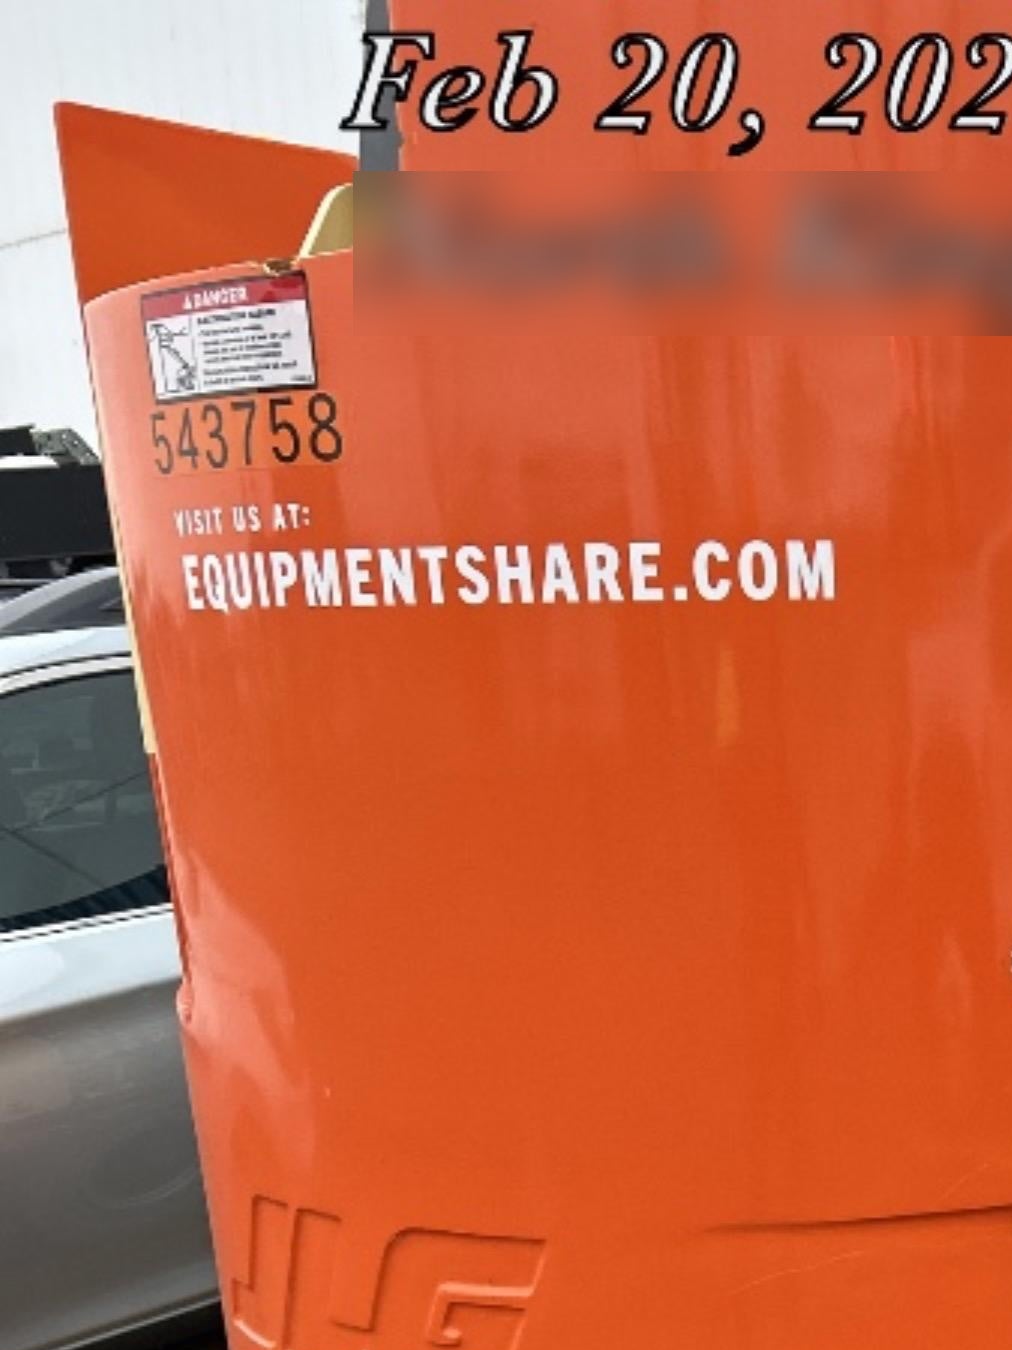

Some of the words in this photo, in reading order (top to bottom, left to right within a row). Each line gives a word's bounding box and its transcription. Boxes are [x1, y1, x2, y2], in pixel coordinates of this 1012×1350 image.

[149, 391, 343, 475] 543758
[174, 506, 223, 537] VISIT
[232, 505, 262, 532] US
[272, 503, 310, 530] AT:
[182, 539, 836, 614] EQUIPMENTSHARE.COM
